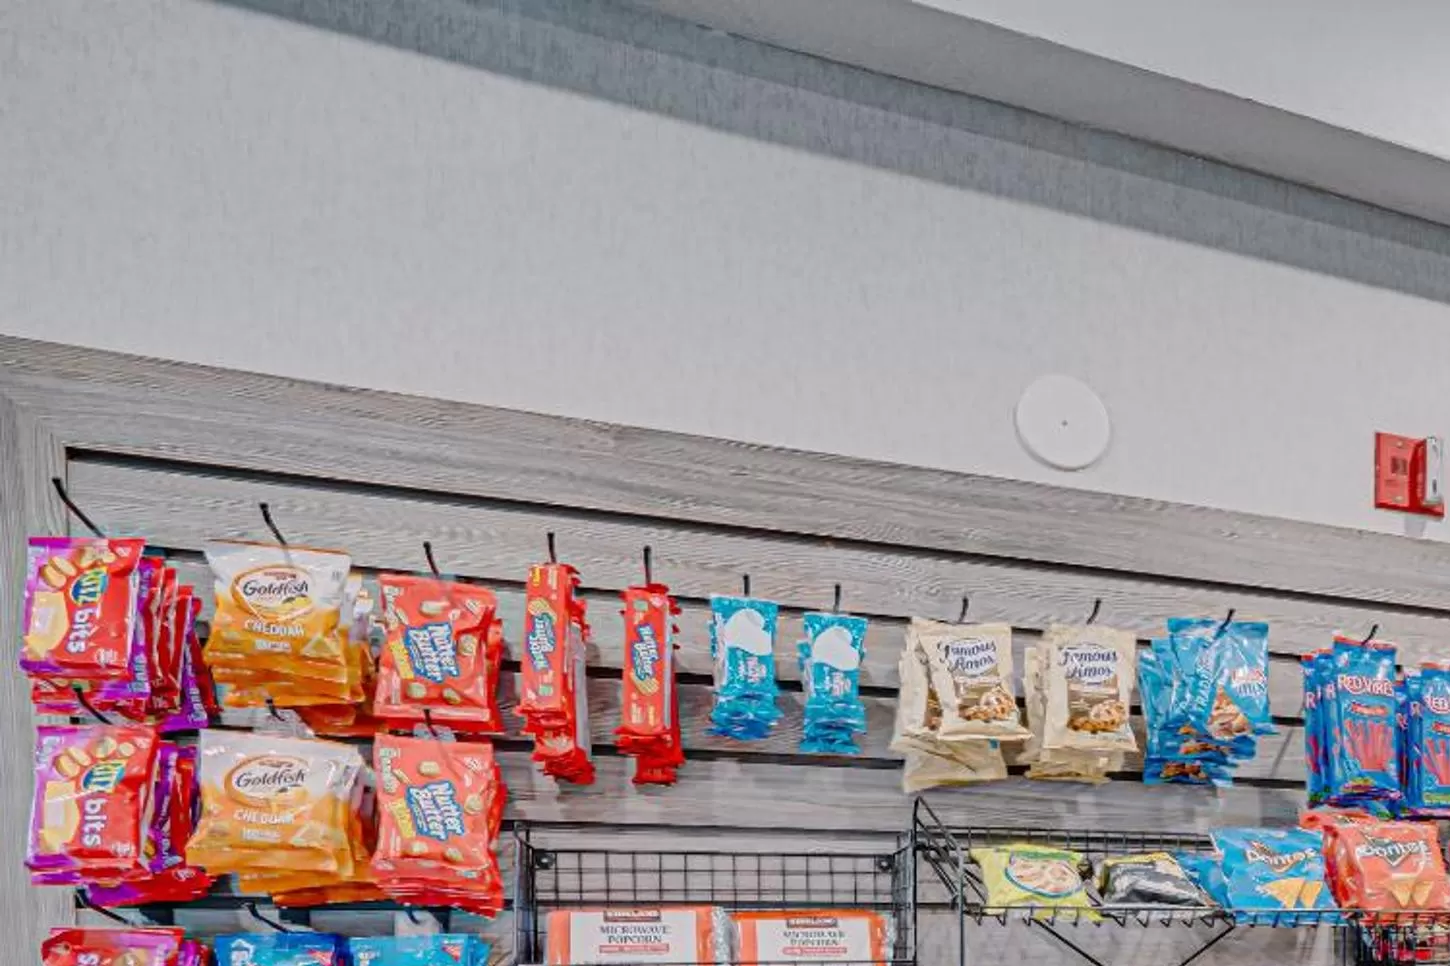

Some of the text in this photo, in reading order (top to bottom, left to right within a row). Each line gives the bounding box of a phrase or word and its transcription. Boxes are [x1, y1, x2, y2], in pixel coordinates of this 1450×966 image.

[242, 579, 309, 598] Goldfish
[66, 607, 100, 653] bits
[427, 623, 459, 676] Nutter
[937, 638, 997, 663] Famous
[1056, 649, 1118, 666] Famous
[236, 769, 305, 788] Goldfish
[409, 787, 446, 840] Butter
[427, 782, 464, 835] Nutter
[82, 798, 108, 847] bits
[1355, 840, 1427, 857] Doritos
[600, 925, 669, 935] MICROWAVE
[608, 935, 662, 945] POPCORN
